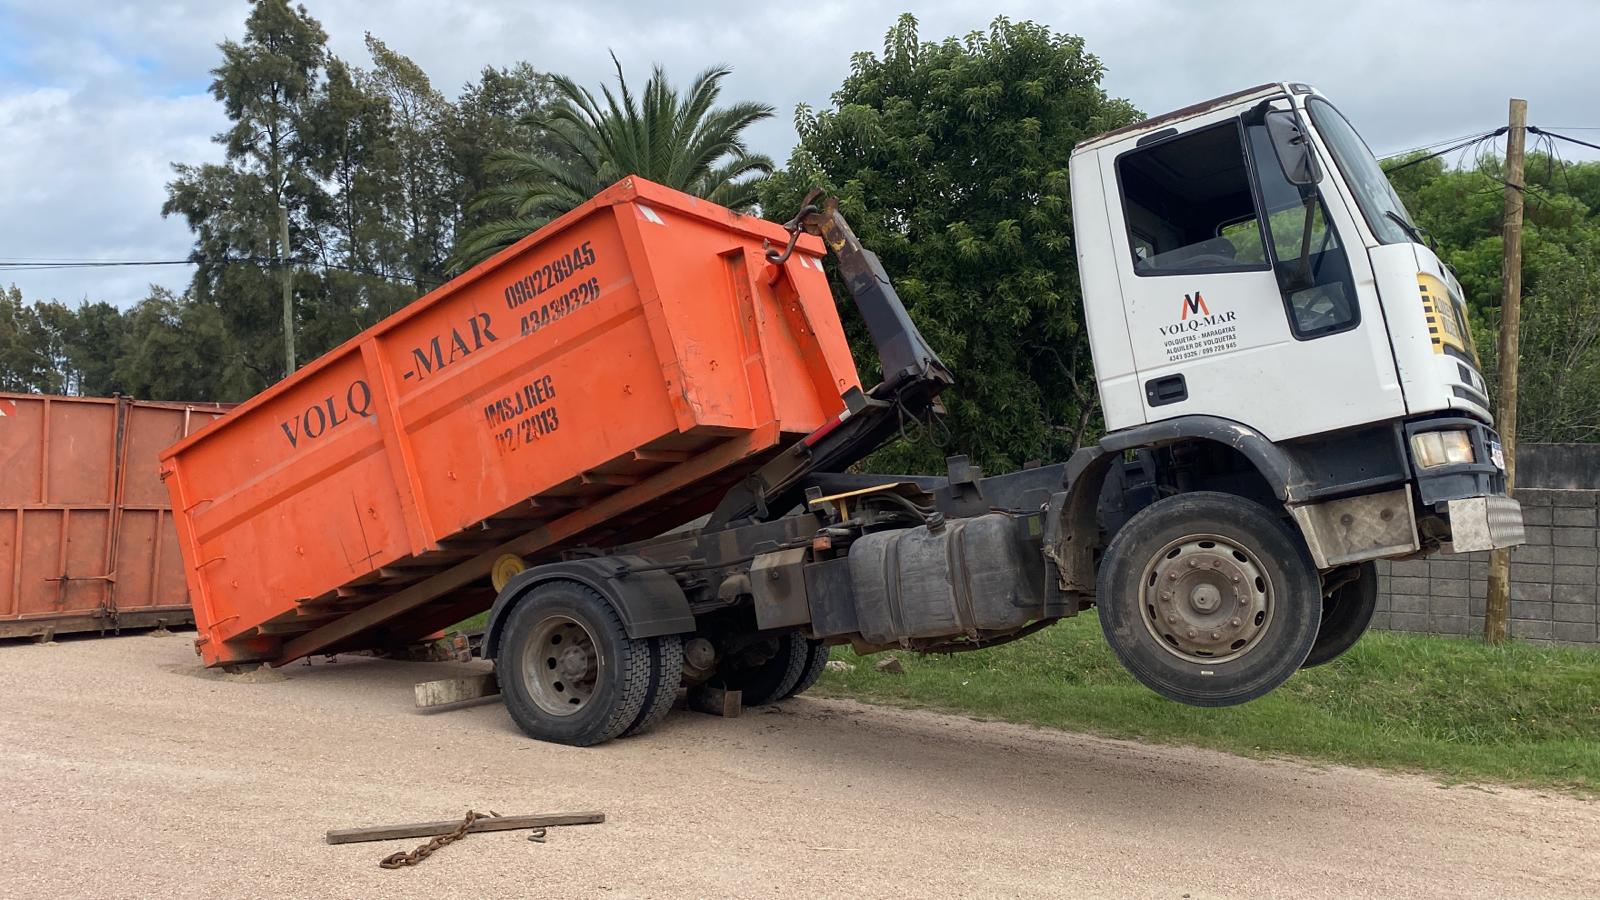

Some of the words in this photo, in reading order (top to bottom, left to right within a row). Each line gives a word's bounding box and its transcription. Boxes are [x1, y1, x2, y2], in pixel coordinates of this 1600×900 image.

[504, 240, 596, 310] 099228945
[1159, 310, 1237, 336] VOLQ-MAR
[1164, 334, 1197, 348] VOLQUETAS
[1201, 325, 1236, 339] MARAGATAS
[1166, 342, 1194, 355] ALQUILER
[1194, 341, 1203, 349] DE
[1203, 333, 1237, 347] VOLQUETAS
[1225, 341, 1238, 351] 945
[280, 380, 374, 449] VOLQ
